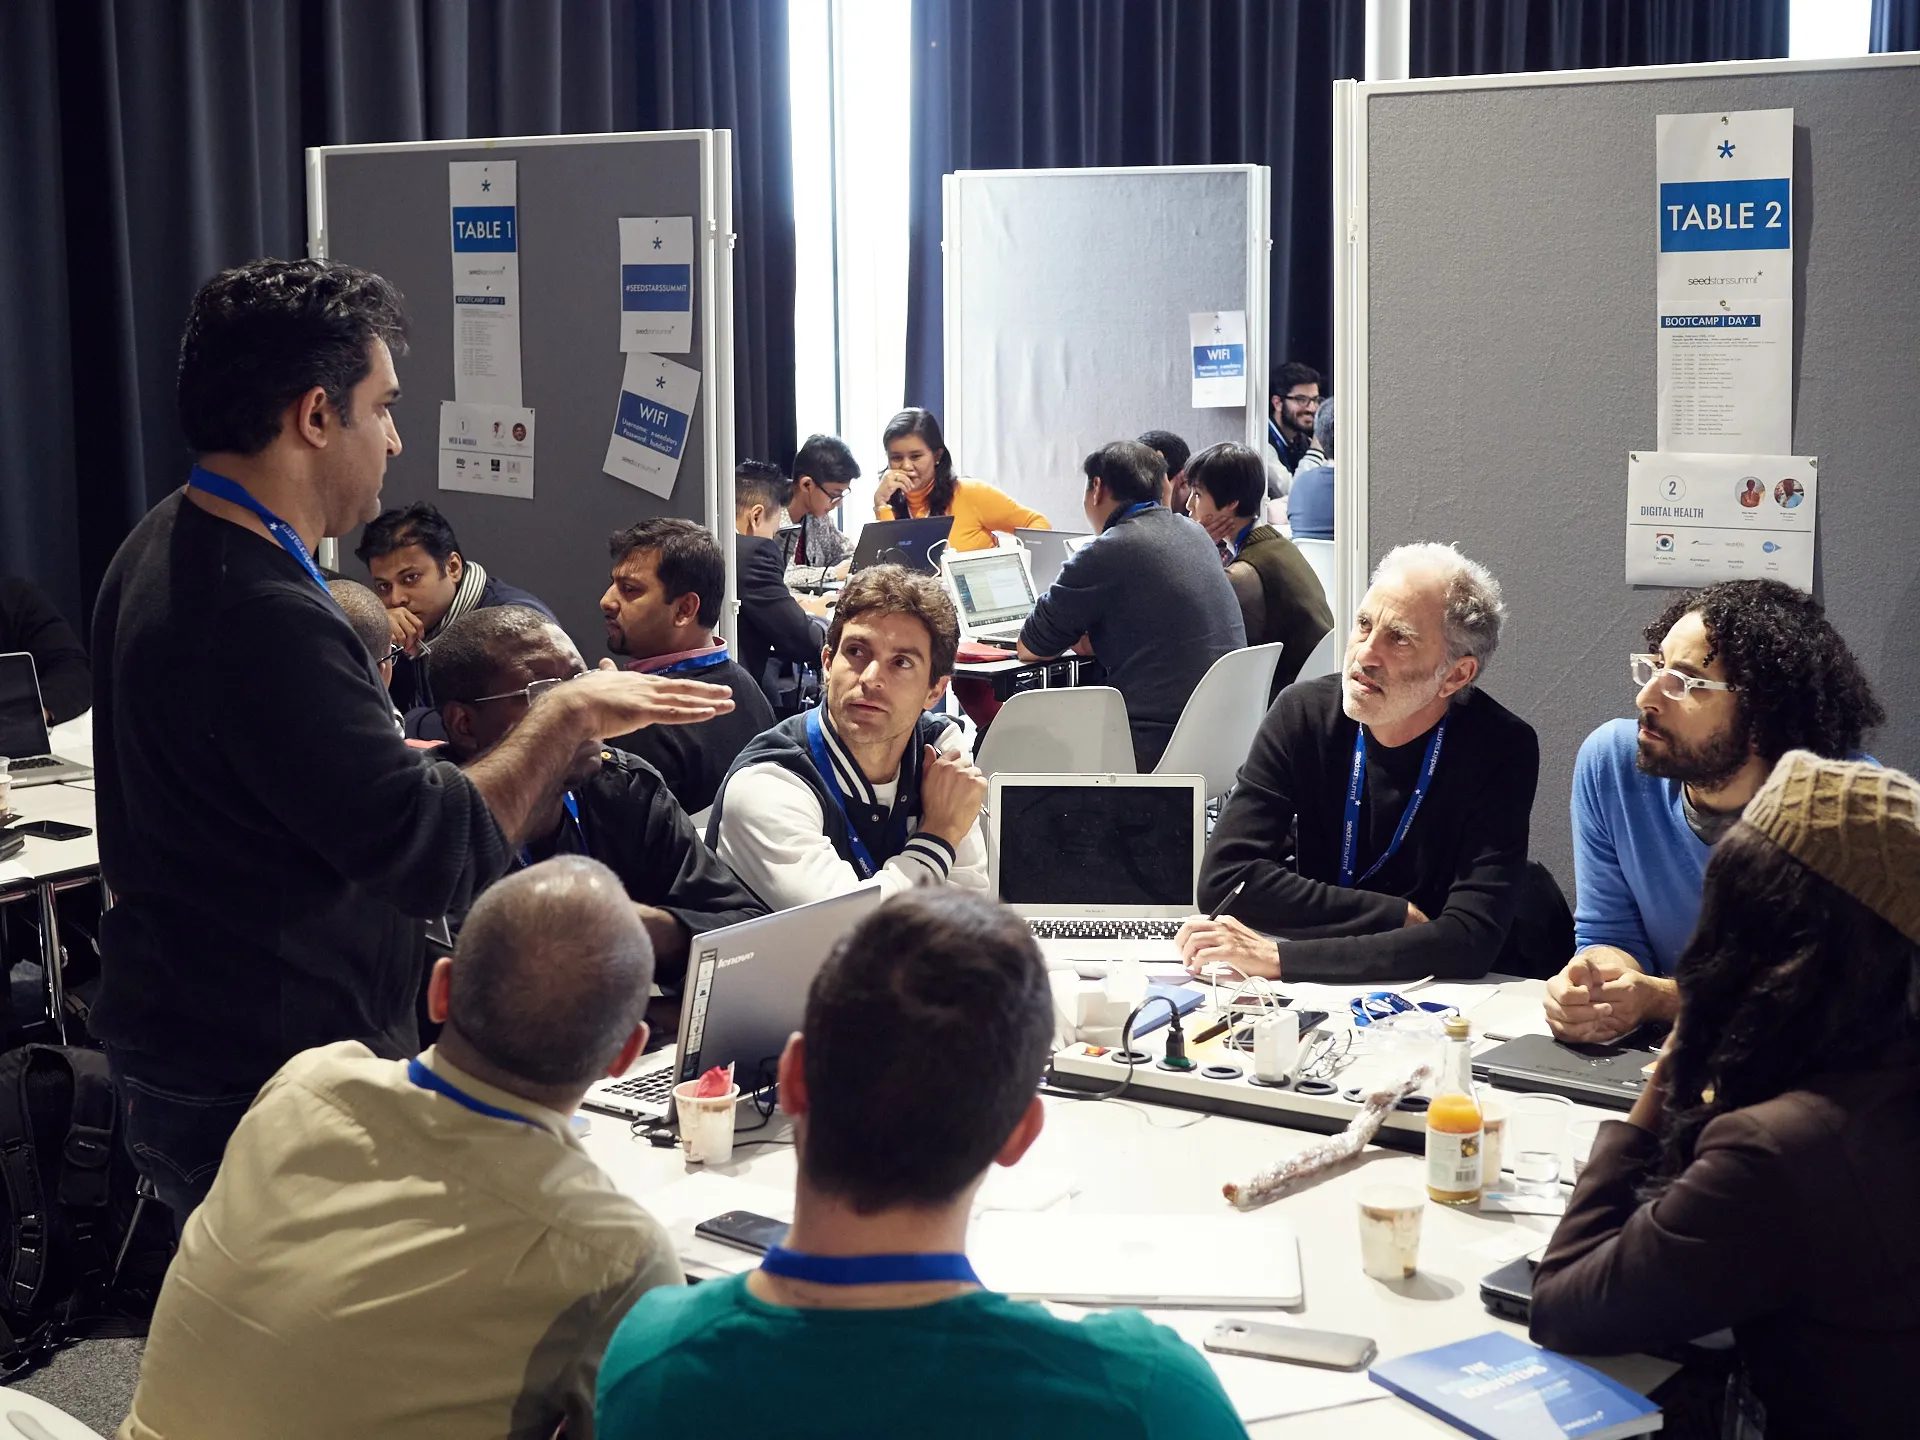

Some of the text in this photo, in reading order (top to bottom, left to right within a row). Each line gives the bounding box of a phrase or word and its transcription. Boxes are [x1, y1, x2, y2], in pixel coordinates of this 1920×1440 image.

[1667, 201, 1782, 231] TABLE 2
[456, 220, 513, 239] TABLE 1
[625, 284, 687, 293] #SEEDSTARSSUMMIT
[1665, 316, 1720, 327] BOOTCAMP
[1728, 316, 1749, 326] DAY
[1207, 349, 1231, 361] WIFI
[639, 402, 668, 428] WIFI
[1668, 480, 1677, 496] 2
[1640, 505, 1704, 519] DIGITAL HEALTH
[717, 951, 755, 969] lenovo
